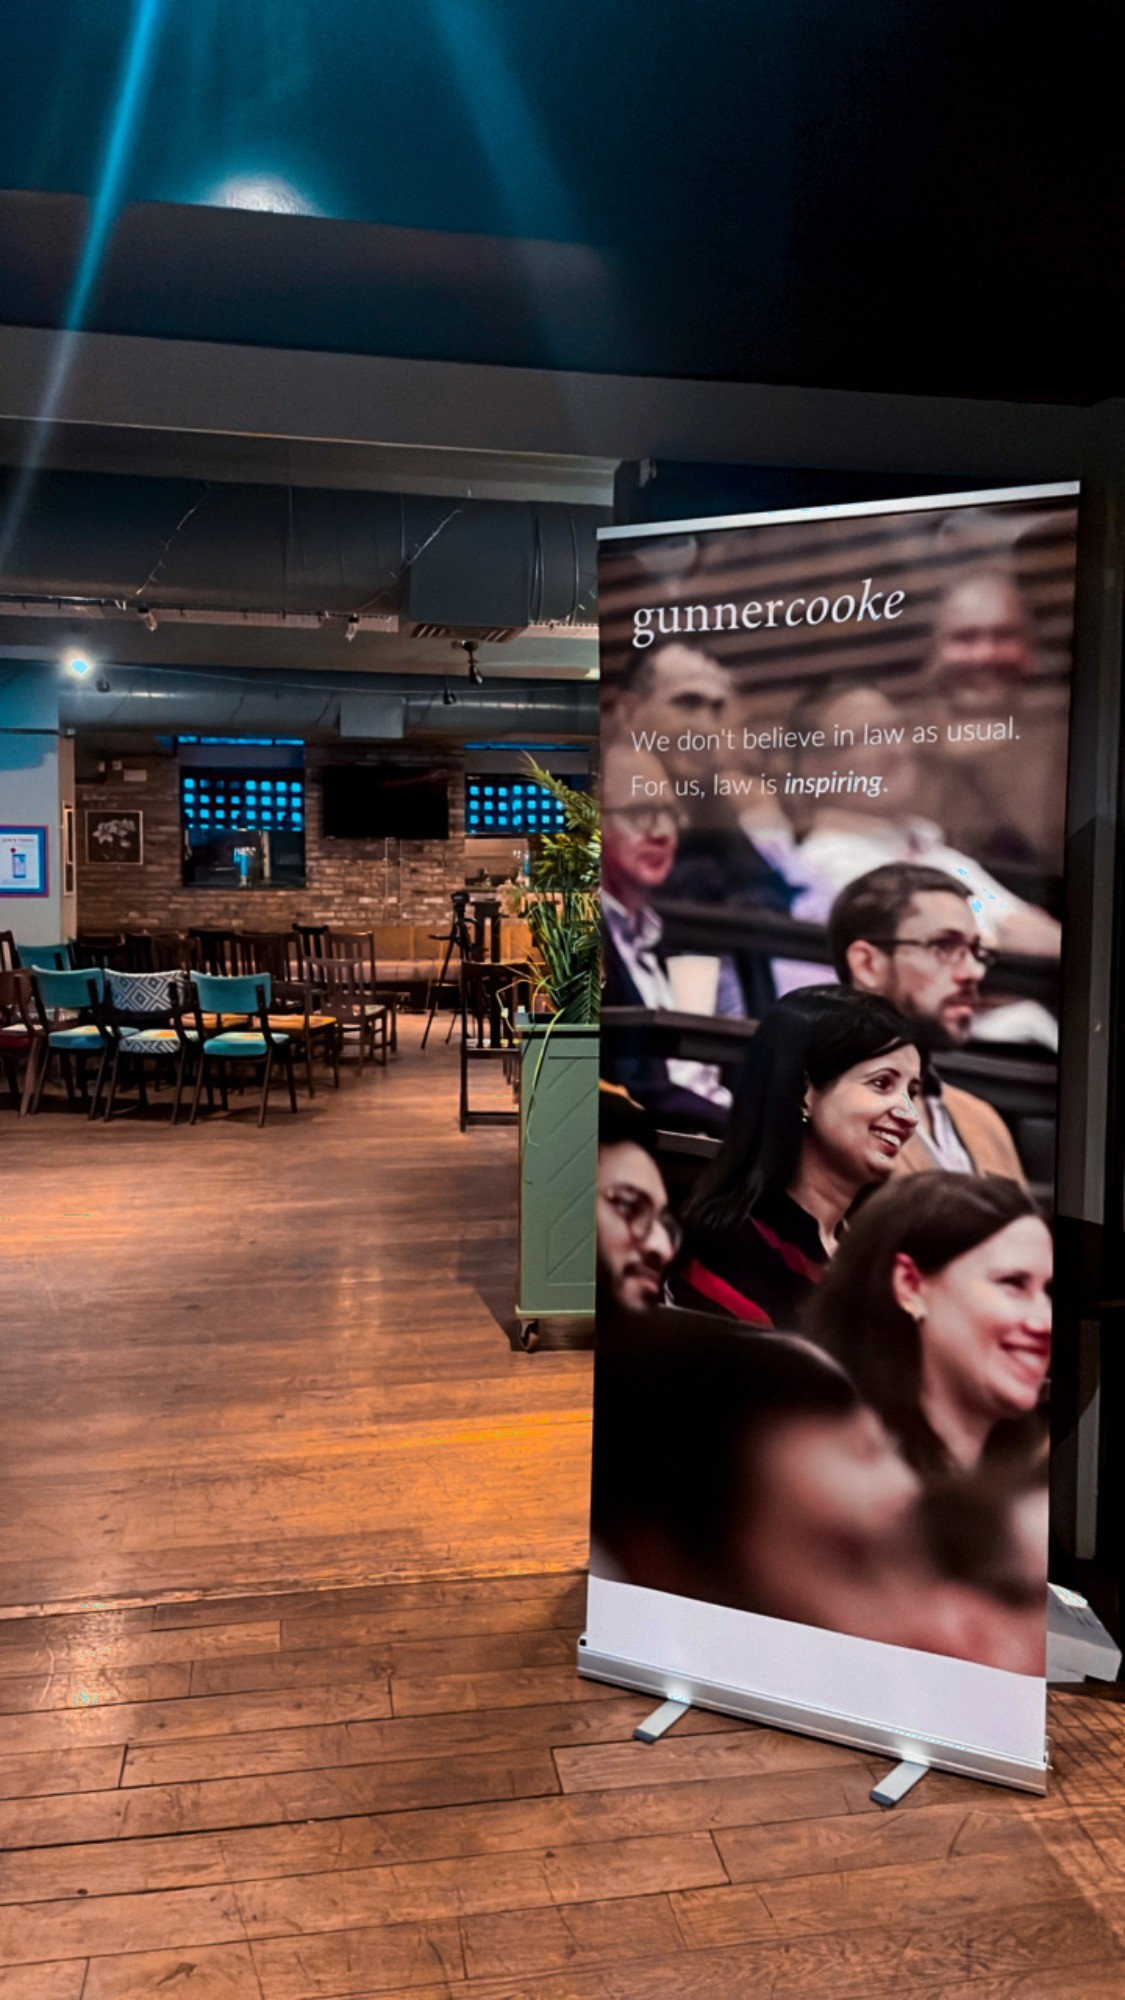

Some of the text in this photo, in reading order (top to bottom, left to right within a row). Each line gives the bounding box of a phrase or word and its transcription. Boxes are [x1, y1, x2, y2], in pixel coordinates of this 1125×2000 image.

[632, 578, 905, 648] gunnercooke
[631, 716, 1021, 752] We don't believe in law as usual.
[631, 770, 889, 798] For us, law is inspiring.
